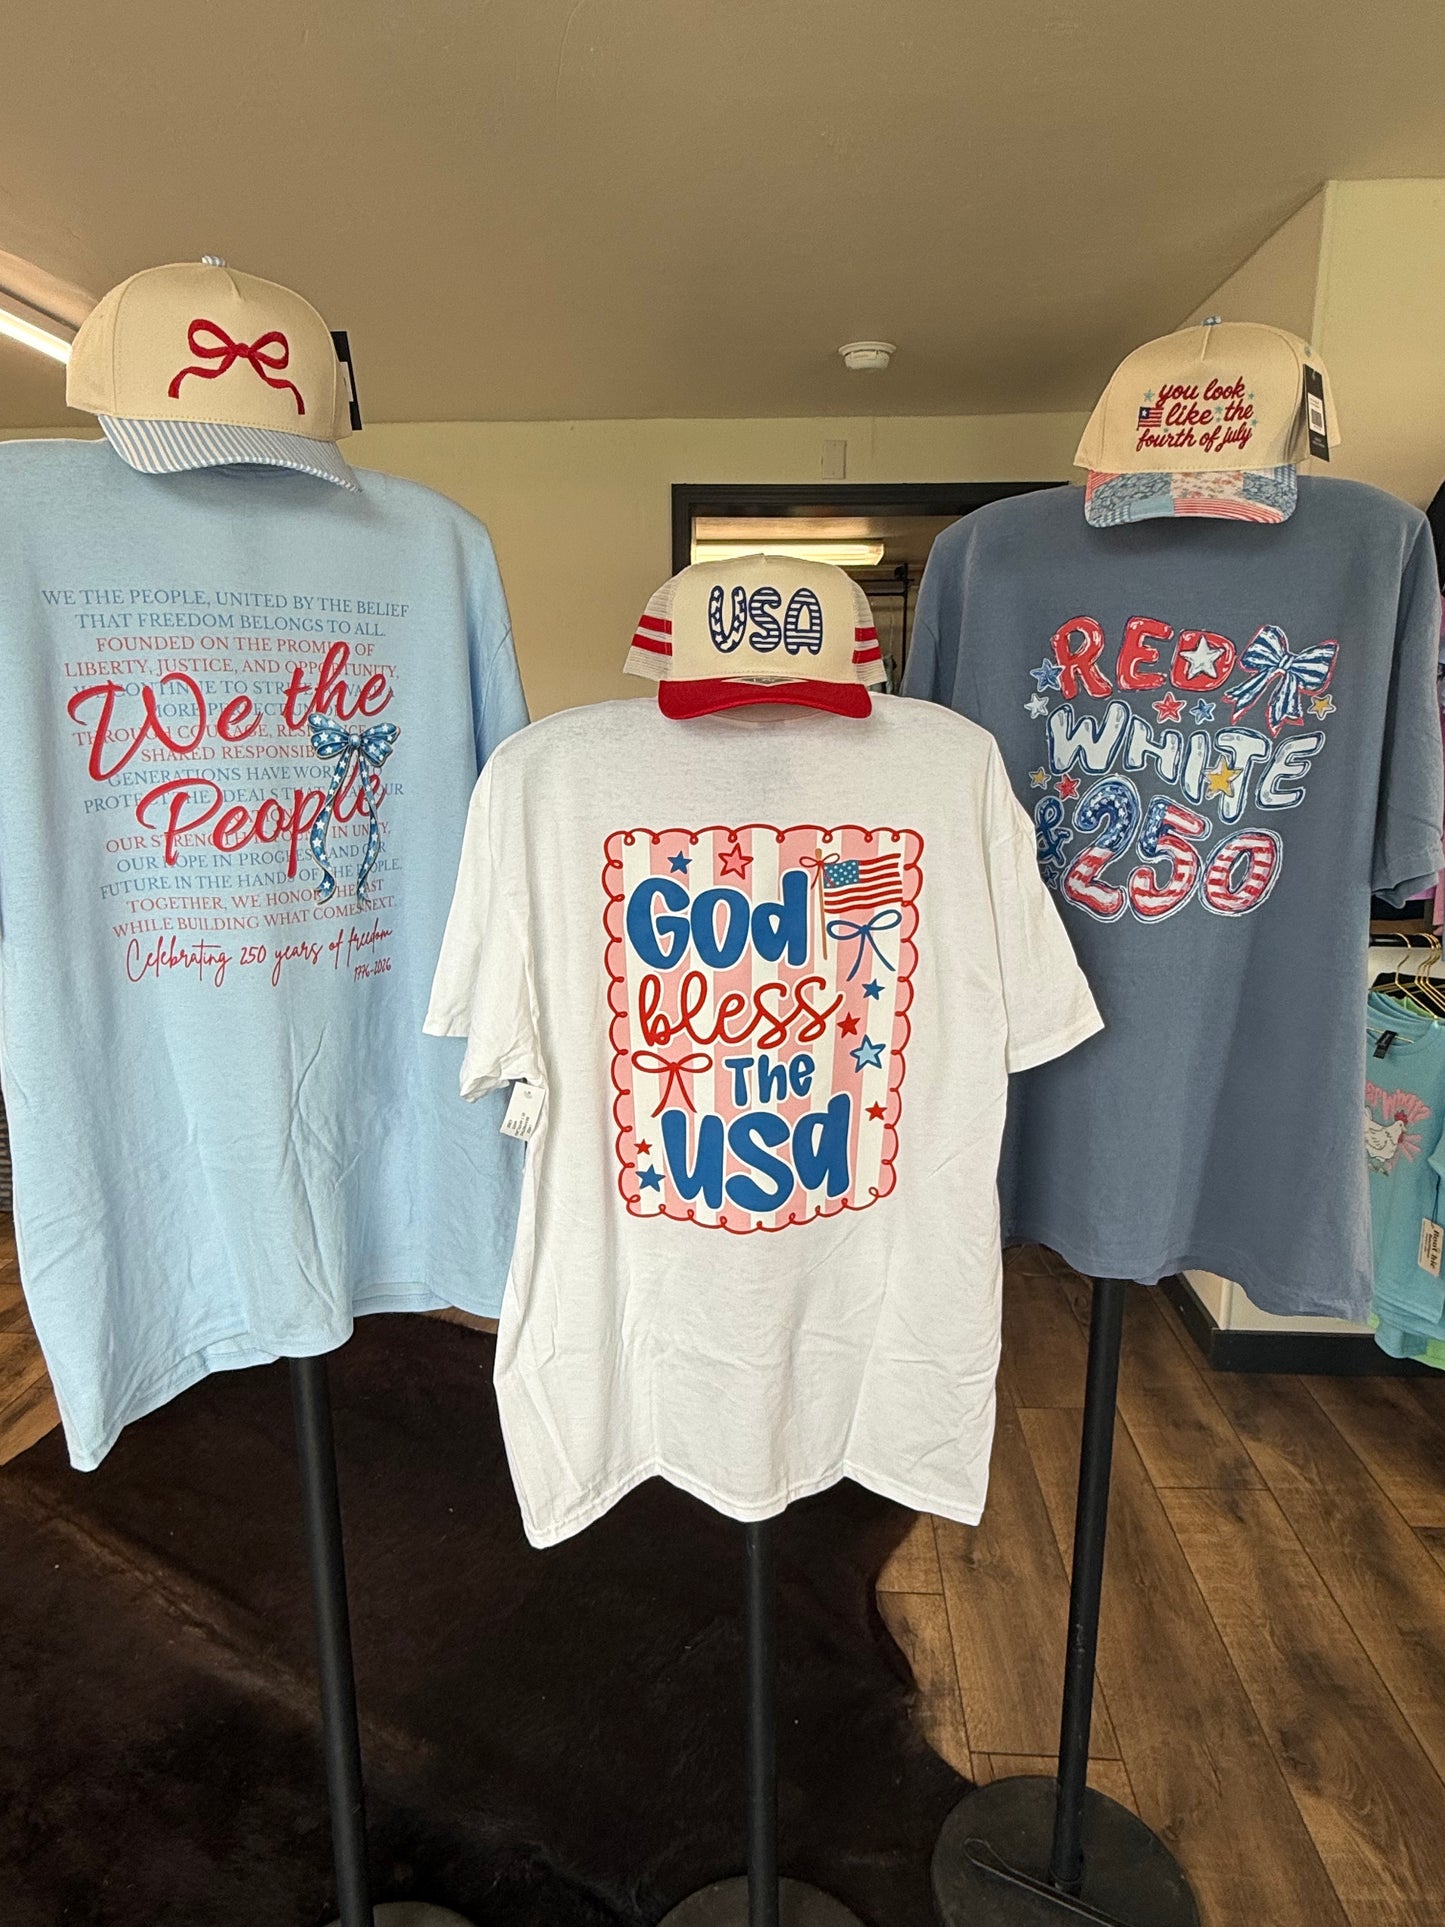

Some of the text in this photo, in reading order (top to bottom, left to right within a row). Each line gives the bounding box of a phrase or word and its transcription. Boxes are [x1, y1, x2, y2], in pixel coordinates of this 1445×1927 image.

[1155, 376, 1245, 409] you look
[1165, 399, 1254, 426] like the
[1136, 422, 1252, 452] fourth of july
[42, 589, 409, 618] WE THE PEOPLE, UNITED BY THE BELIEF
[75, 613, 386, 637] THAT FREEDOM BELONGS TO ALL.
[709, 585, 823, 656] USA
[96, 636, 375, 658] FOUNDED ON THE PROM OF
[1050, 615, 1237, 700] RED
[64, 659, 152, 678] LIBERTY,
[156, 658, 238, 676] JUSTICE,
[242, 659, 280, 673] AND
[113, 680, 216, 698] OTINE
[220, 681, 248, 695] TO
[253, 681, 313, 697] STRE
[67, 641, 393, 782] We the
[109, 767, 241, 788] GENERATIONS
[247, 766, 290, 780] HAVE
[1046, 699, 1326, 825] WHITE
[173, 789, 211, 804] HE
[222, 786, 278, 803] DEALS
[378, 782, 404, 796] UR
[136, 758, 387, 879] People
[106, 836, 147, 853] OUR
[332, 825, 348, 838] IN
[353, 821, 390, 837] UNY,
[1062, 774, 1284, 924] 250
[117, 856, 159, 872] OUR
[214, 853, 232, 867] IN
[239, 849, 313, 867] PROGES
[328, 844, 360, 859] AND
[100, 876, 171, 899] FUTURE
[175, 875, 192, 889] IN
[195, 875, 232, 889] THE
[299, 867, 319, 882] OF
[333, 864, 353, 878] HE
[357, 857, 402, 876] POPLE.
[126, 878, 384, 913] TOGETHER, WE HONOR HE AST
[113, 917, 173, 938] WHILE
[178, 916, 259, 931] BUILDING
[264, 909, 310, 926] WHAT
[313, 903, 362, 920] COMES
[126, 917, 393, 988] Celebrating 250 years of freedom
[353, 957, 392, 983] 1776-2026
[638, 970, 843, 1050] bless
[725, 1053, 815, 1107] The
